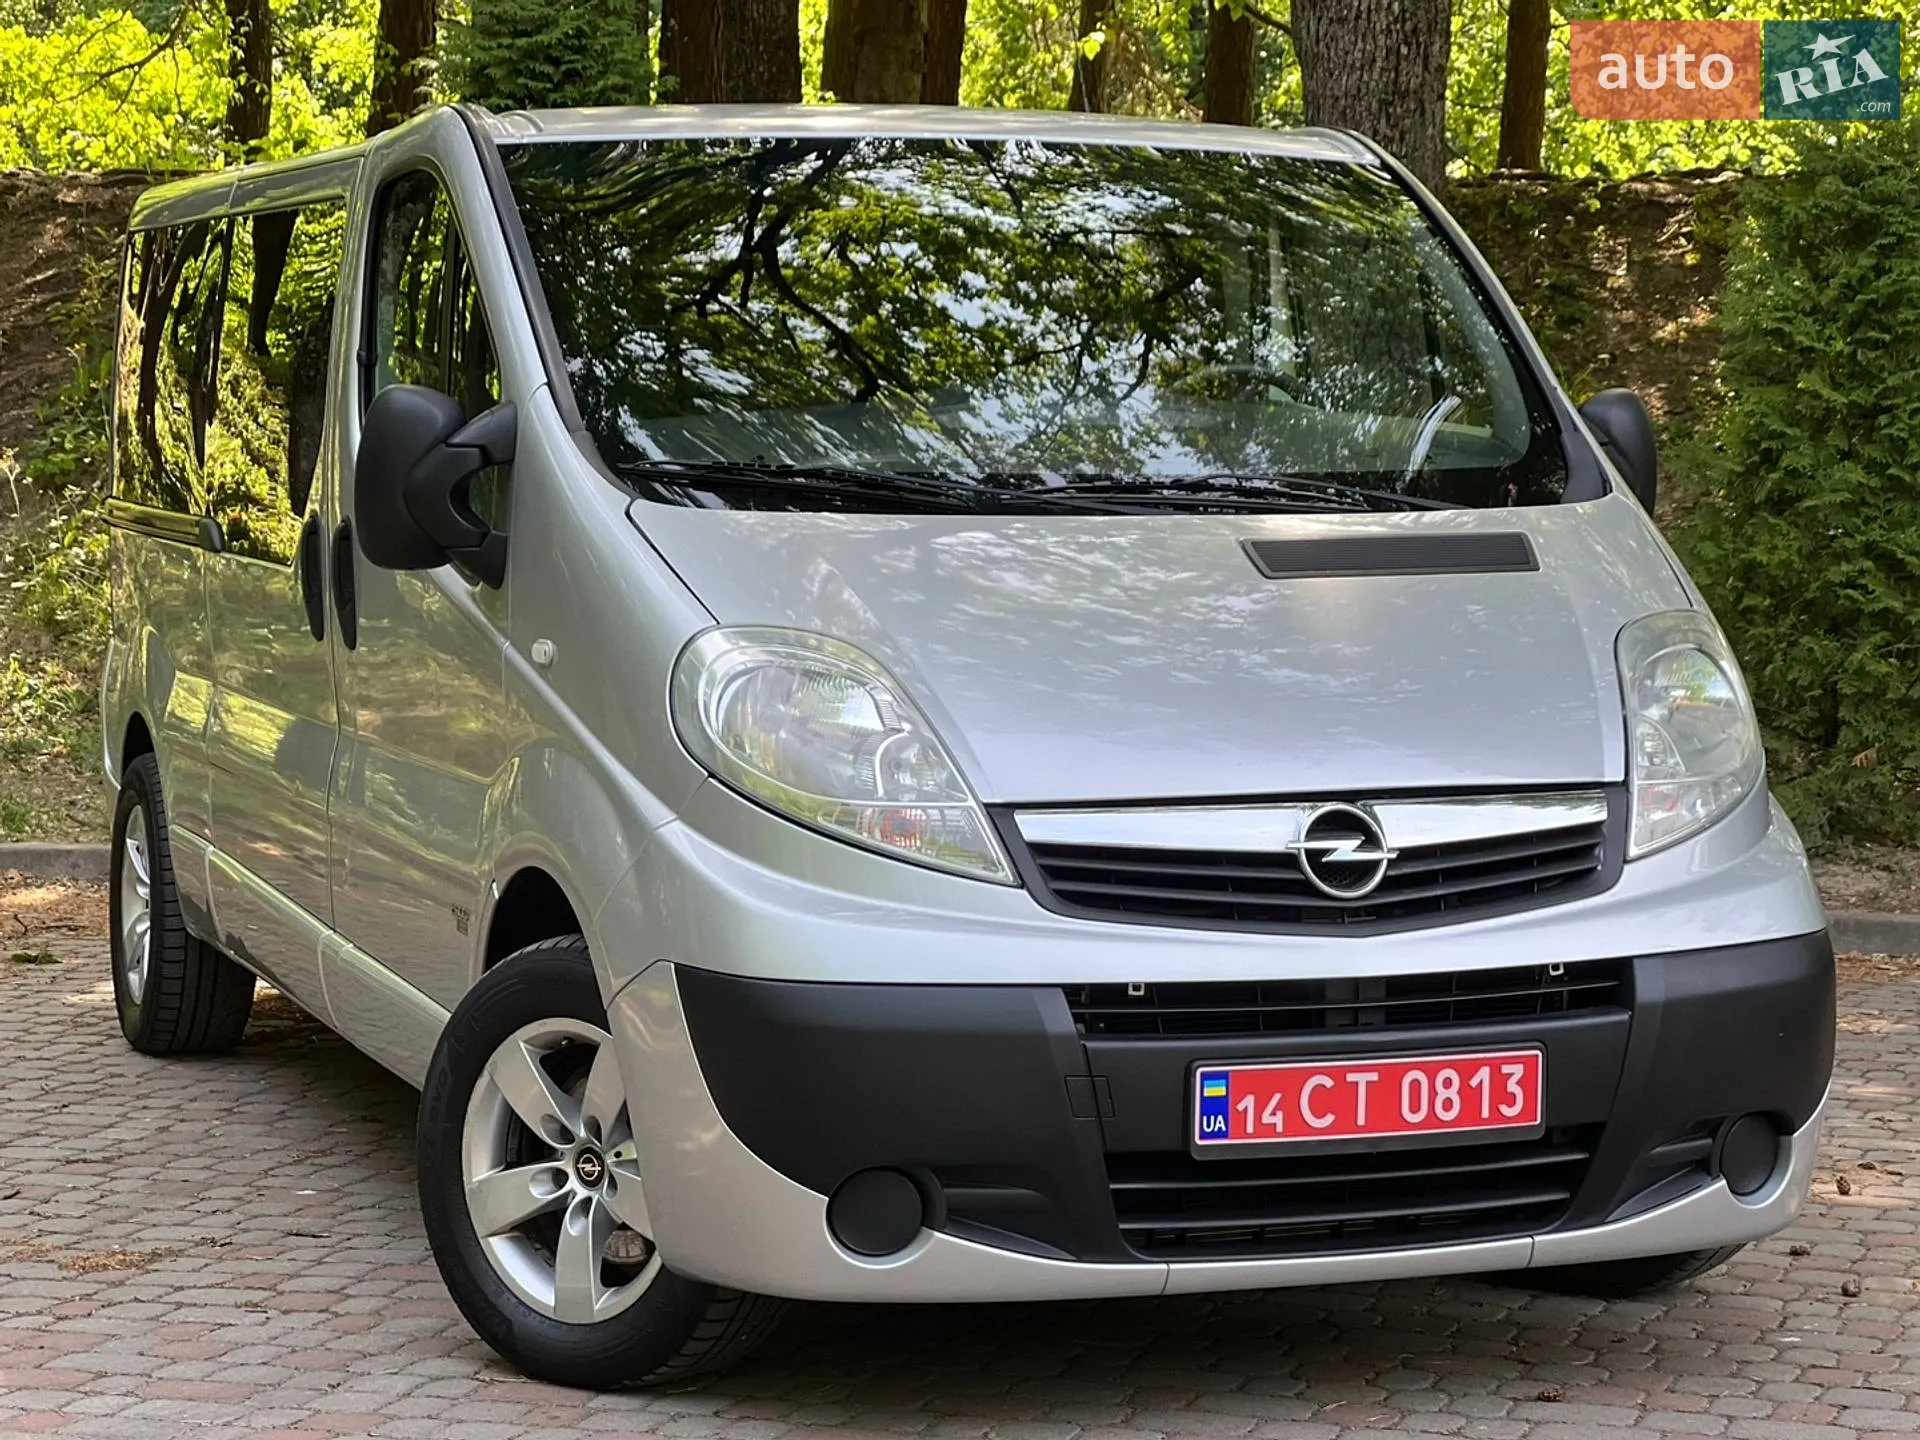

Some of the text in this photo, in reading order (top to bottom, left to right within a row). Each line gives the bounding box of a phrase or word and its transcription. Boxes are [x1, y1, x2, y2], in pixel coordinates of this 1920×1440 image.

[1236, 1063, 1525, 1135] 14 CT 0813
[1202, 1114, 1227, 1133] UA
